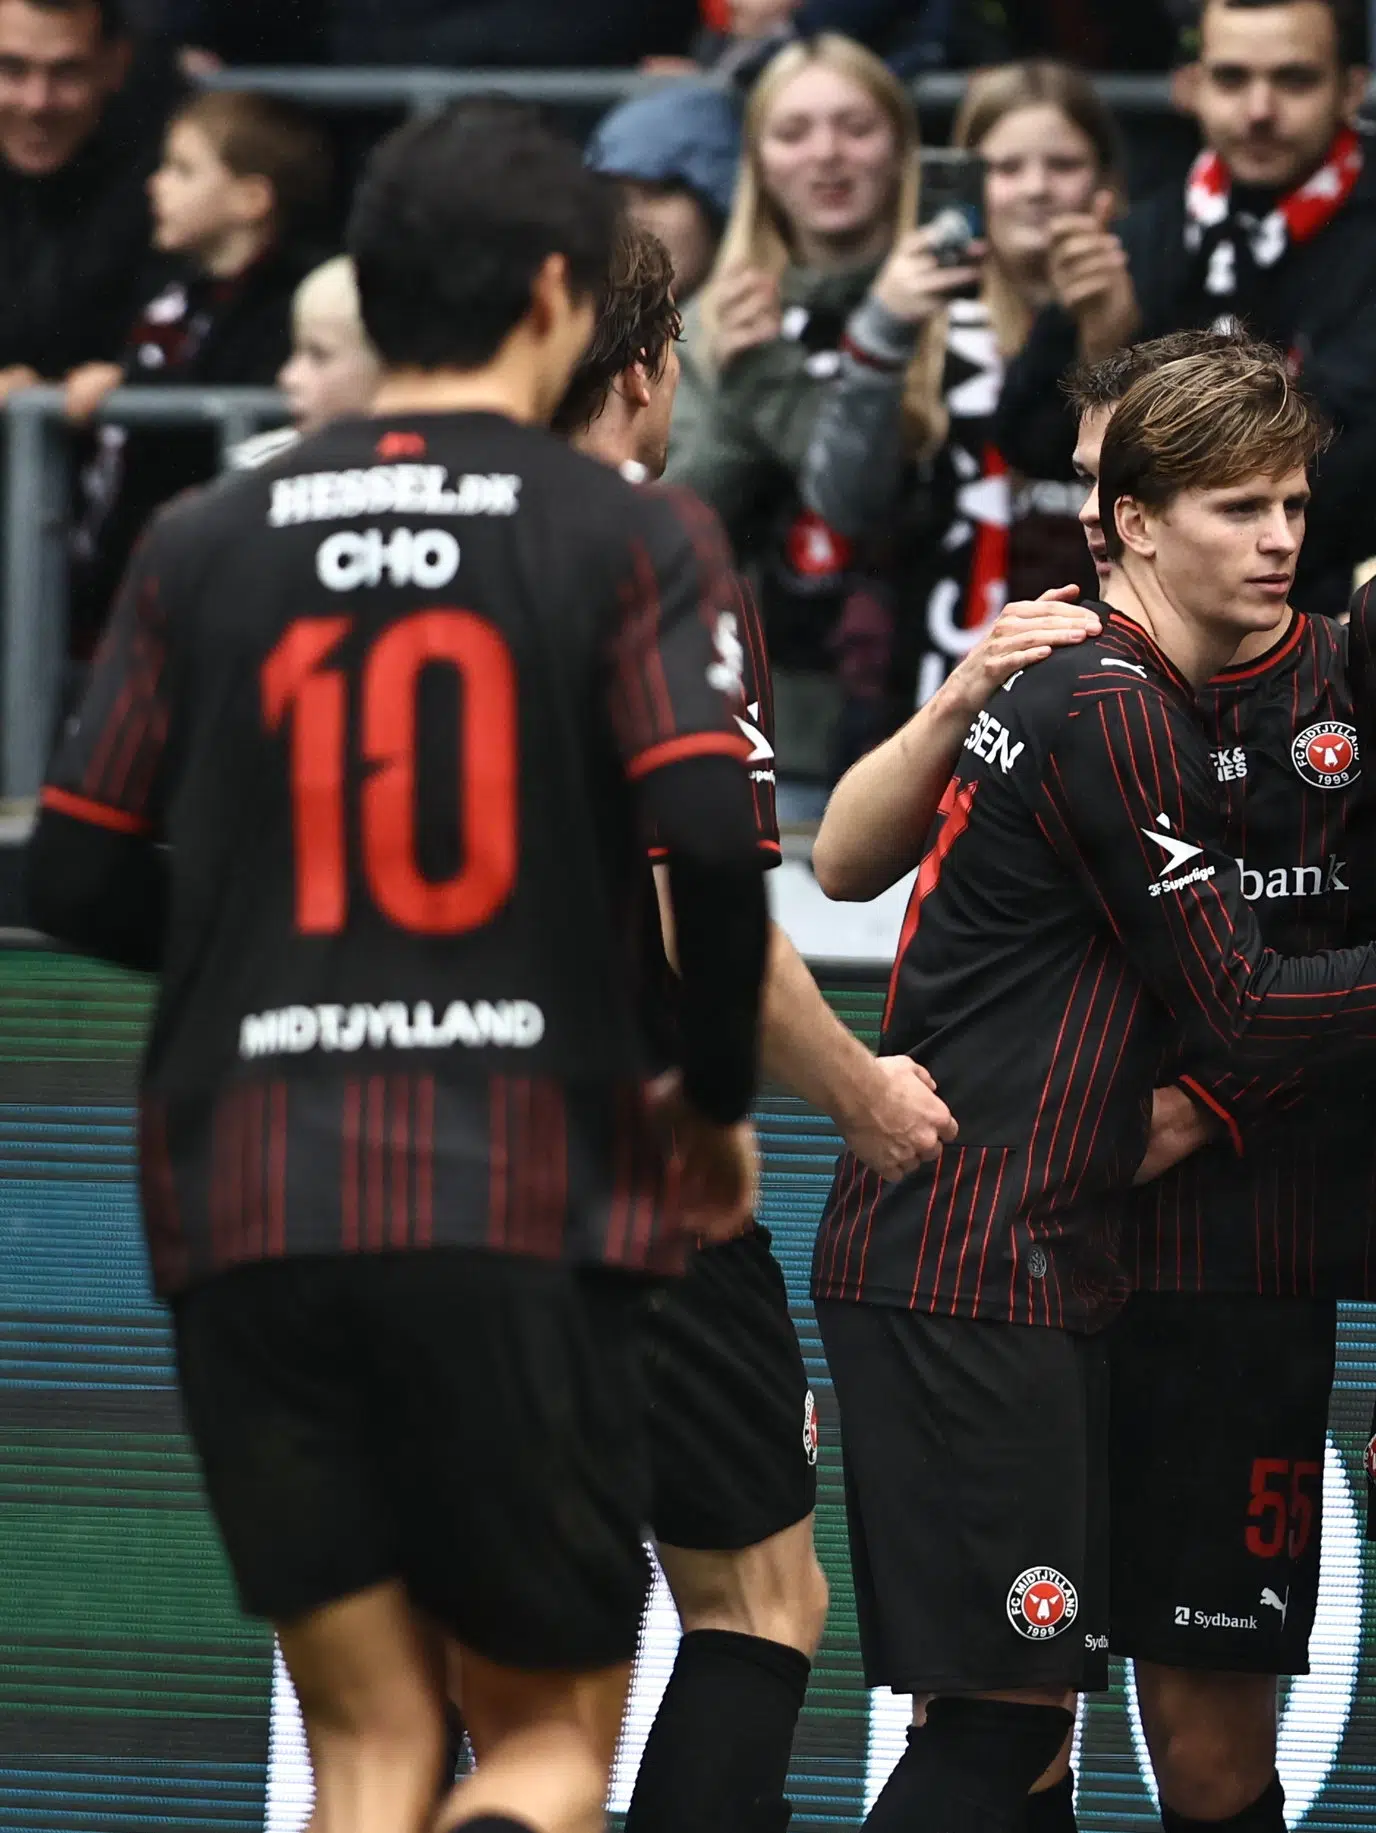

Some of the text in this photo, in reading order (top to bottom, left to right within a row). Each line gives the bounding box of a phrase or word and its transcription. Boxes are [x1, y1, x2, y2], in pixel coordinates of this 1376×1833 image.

[315, 526, 461, 592] CHO
[259, 607, 520, 936] 10
[1318, 771, 1350, 786] 1999
[1161, 865, 1216, 893] Superliga
[239, 998, 546, 1061] MIDTJYLLAND
[1245, 1459, 1321, 1560] 55
[1015, 1570, 1076, 1618] MIDTJYLLAND
[1026, 1625, 1055, 1638] 1999
[1193, 1610, 1259, 1630] Sydbank
